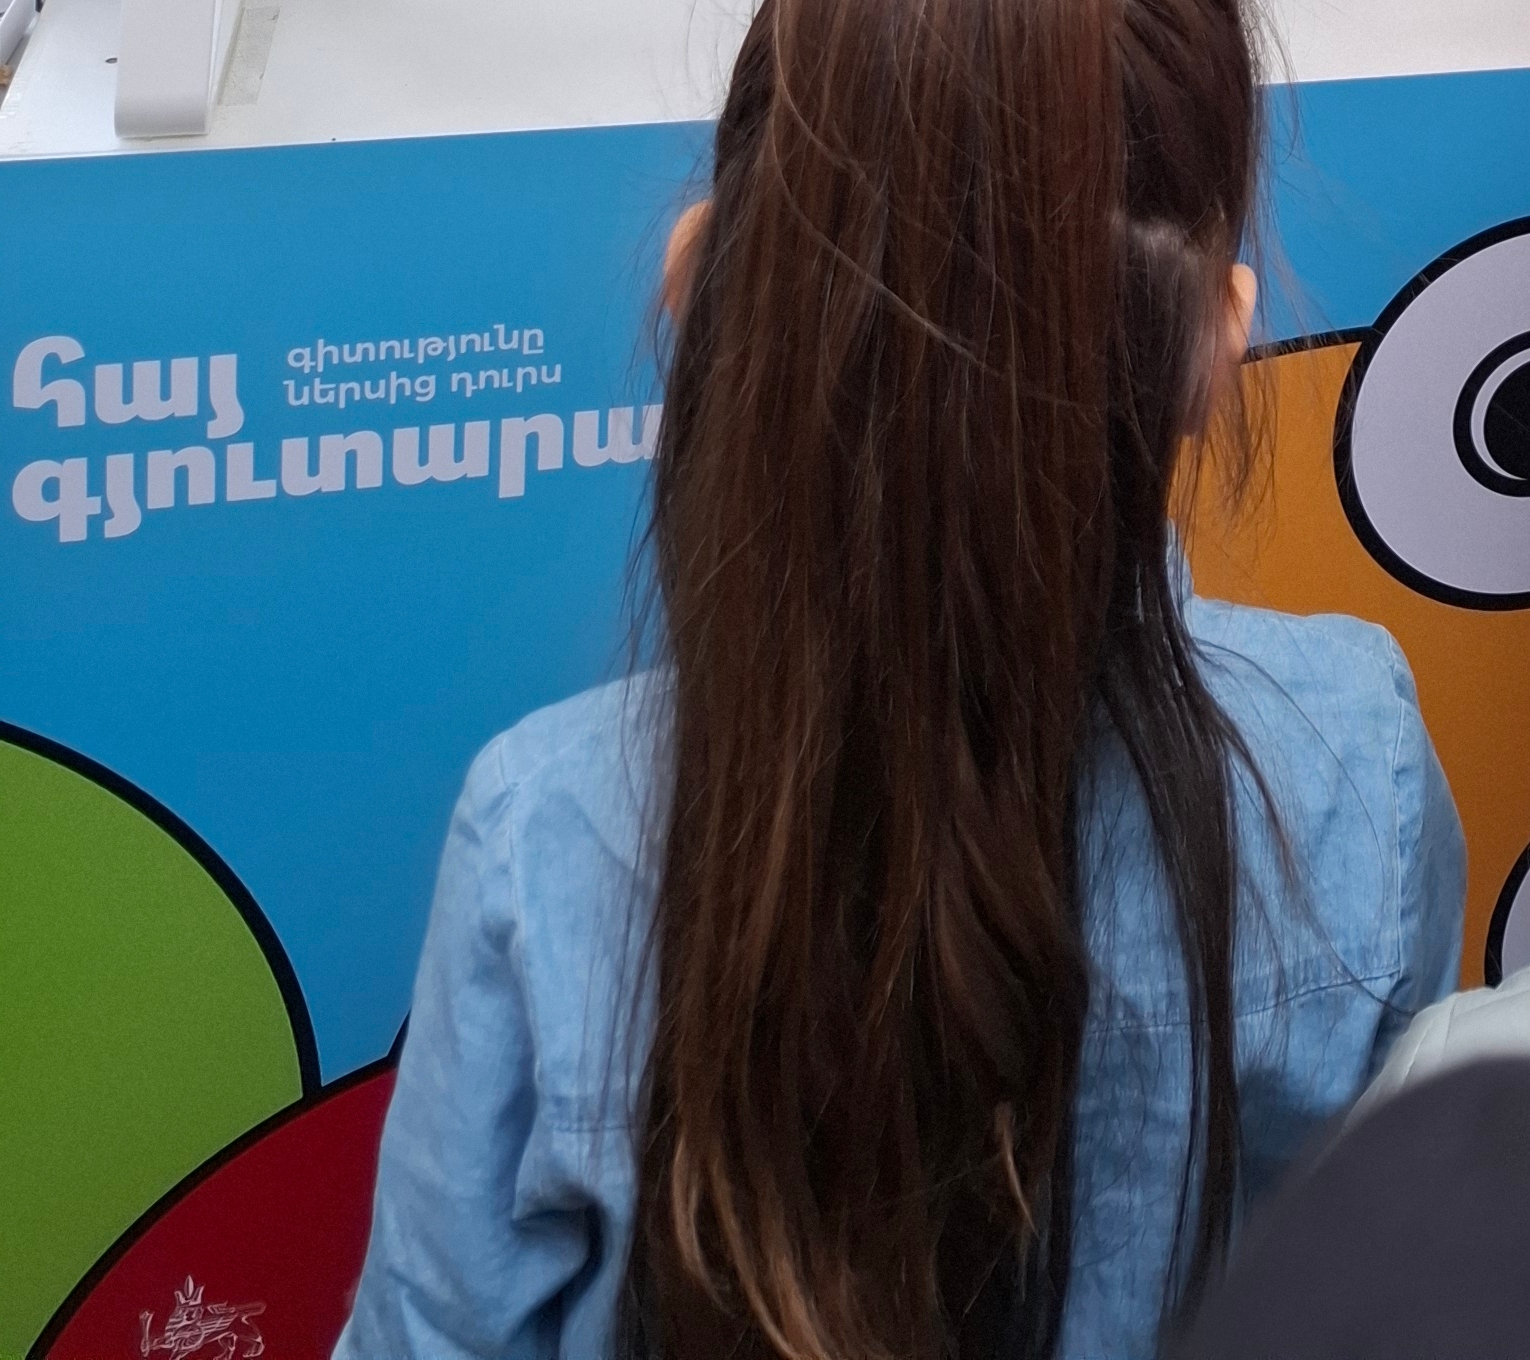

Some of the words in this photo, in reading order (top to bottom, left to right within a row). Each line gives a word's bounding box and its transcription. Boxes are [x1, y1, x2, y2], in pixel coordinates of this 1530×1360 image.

[286, 323, 545, 374] գիտությունը
[283, 370, 437, 409] ներսից
[450, 363, 562, 398] դուրս
[12, 403, 665, 543] գյուտարա
